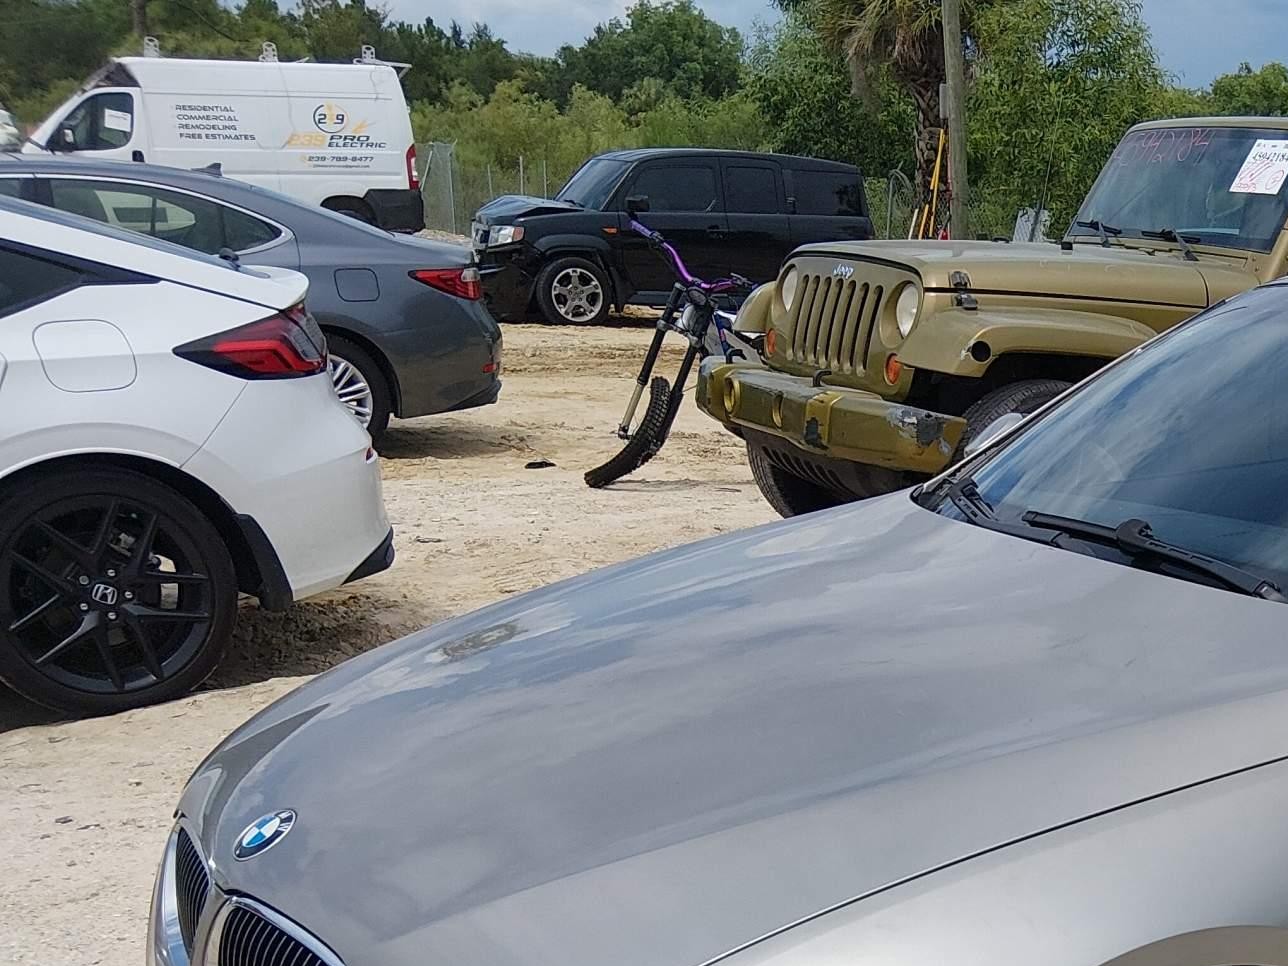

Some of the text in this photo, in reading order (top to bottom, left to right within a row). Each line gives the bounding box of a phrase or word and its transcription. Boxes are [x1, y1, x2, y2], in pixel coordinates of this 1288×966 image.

[175, 104, 235, 112] RESIDENTIAL
[176, 114, 239, 122] COMMERCIAL
[178, 123, 237, 131] REMODELING
[205, 133, 256, 141] ESTIMATES
